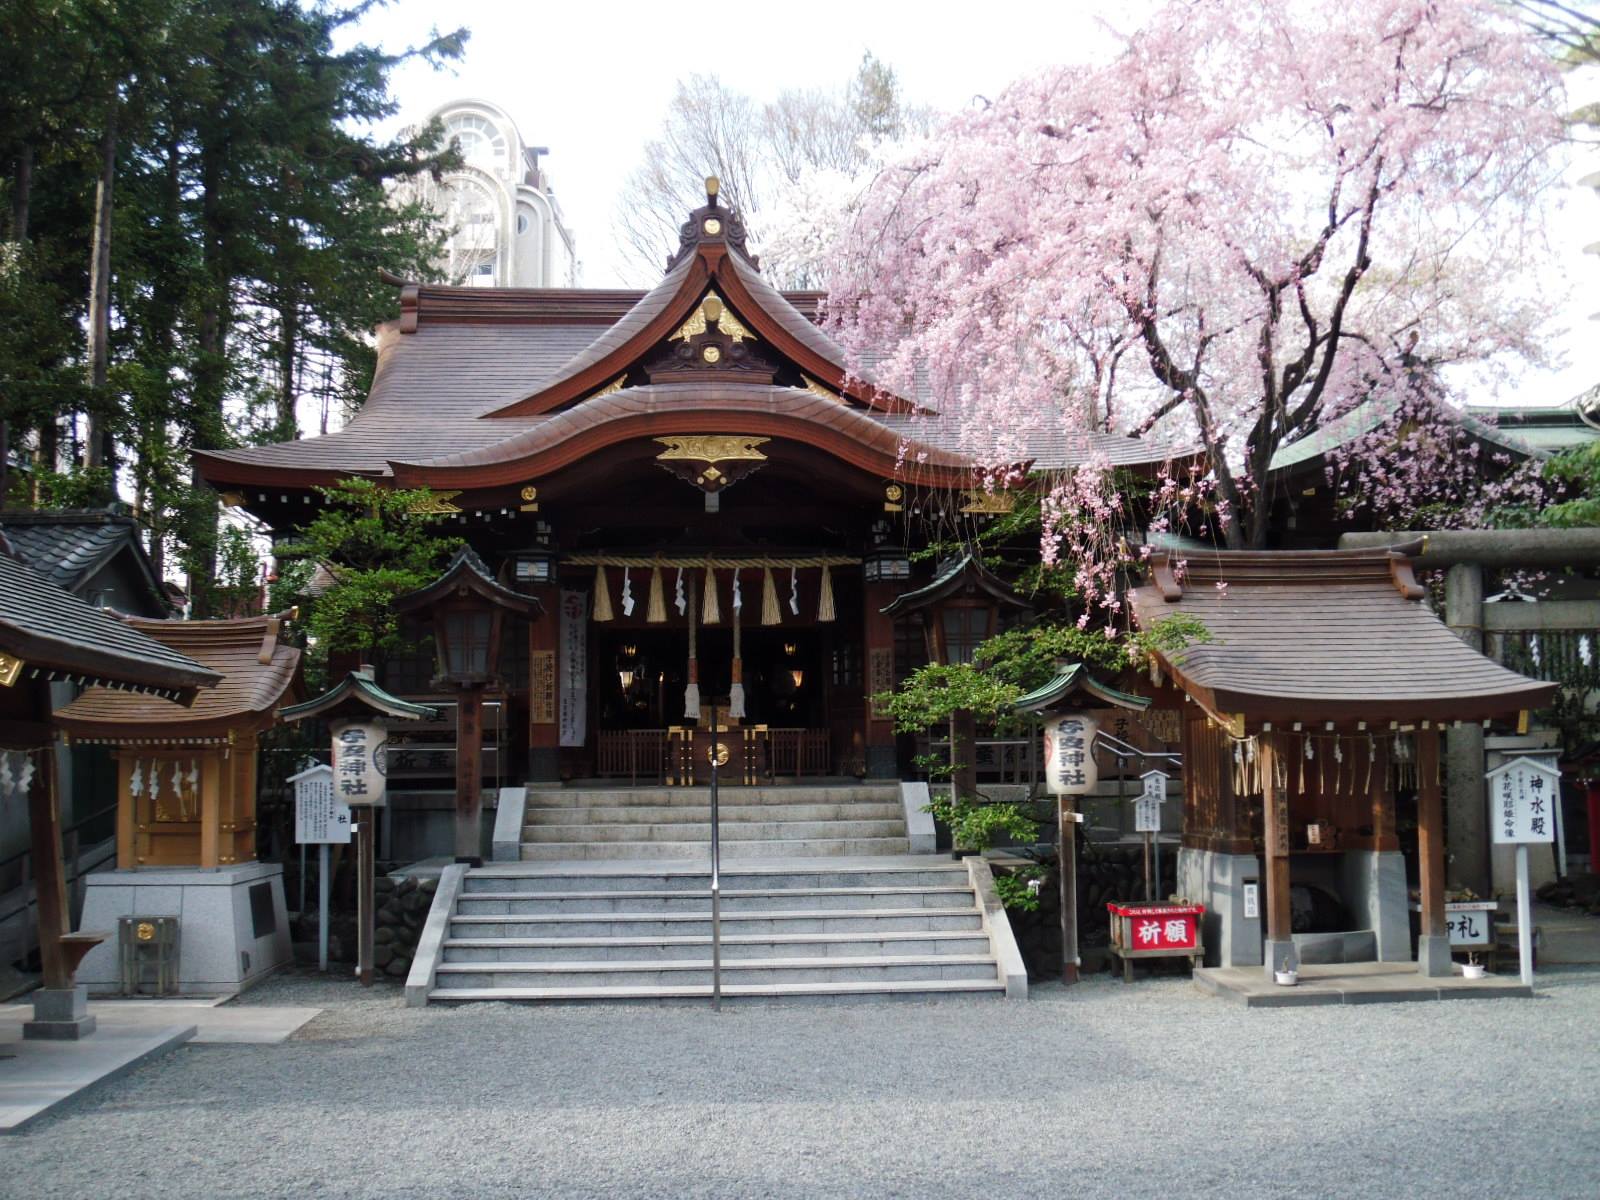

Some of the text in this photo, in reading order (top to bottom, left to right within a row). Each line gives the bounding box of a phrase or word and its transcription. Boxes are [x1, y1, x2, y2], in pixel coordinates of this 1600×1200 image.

[1529, 774, 1547, 835] 神水殿
[1138, 919, 1188, 945] 祈願
